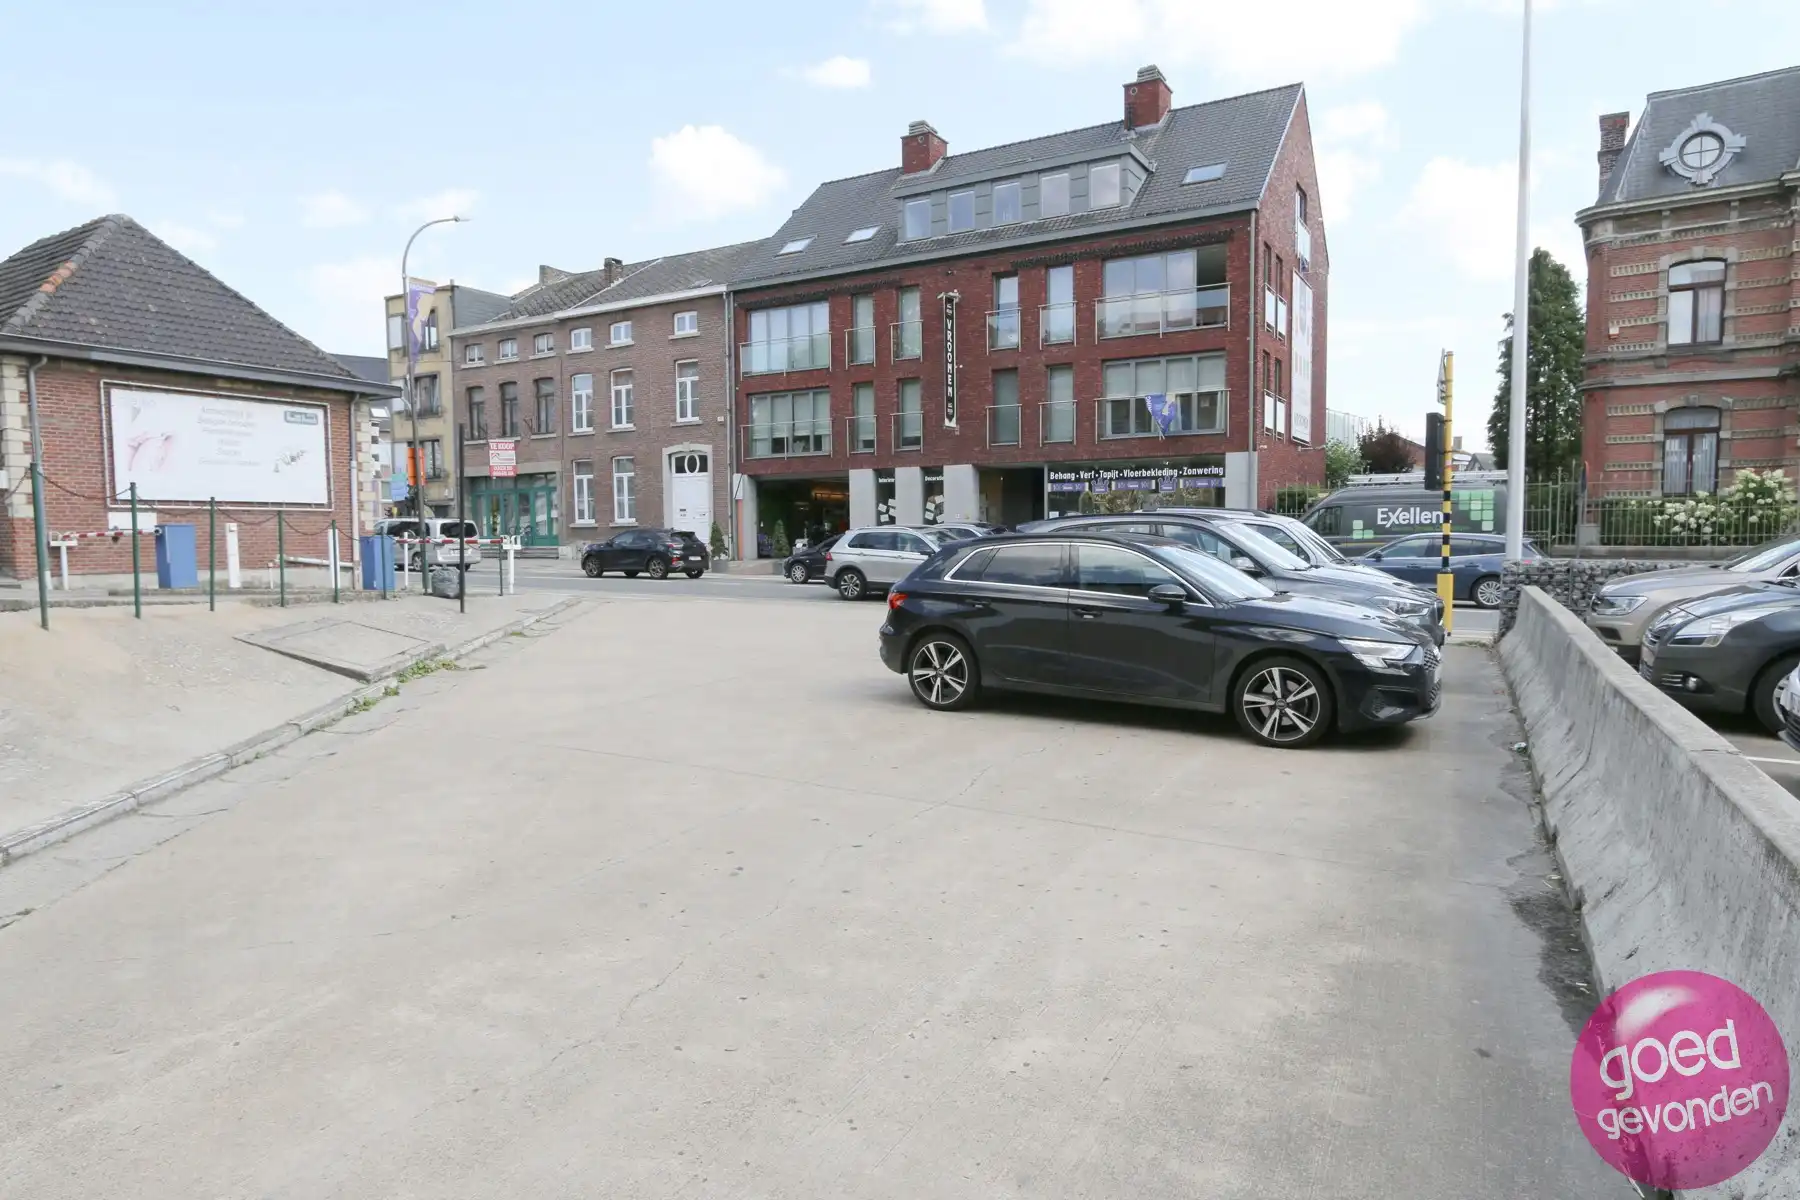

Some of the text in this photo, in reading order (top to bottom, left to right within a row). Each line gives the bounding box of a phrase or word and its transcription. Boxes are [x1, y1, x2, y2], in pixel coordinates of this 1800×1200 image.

[1050, 466, 1224, 481] Behang Verf Tapijt Vloerbekleding Zonwering
